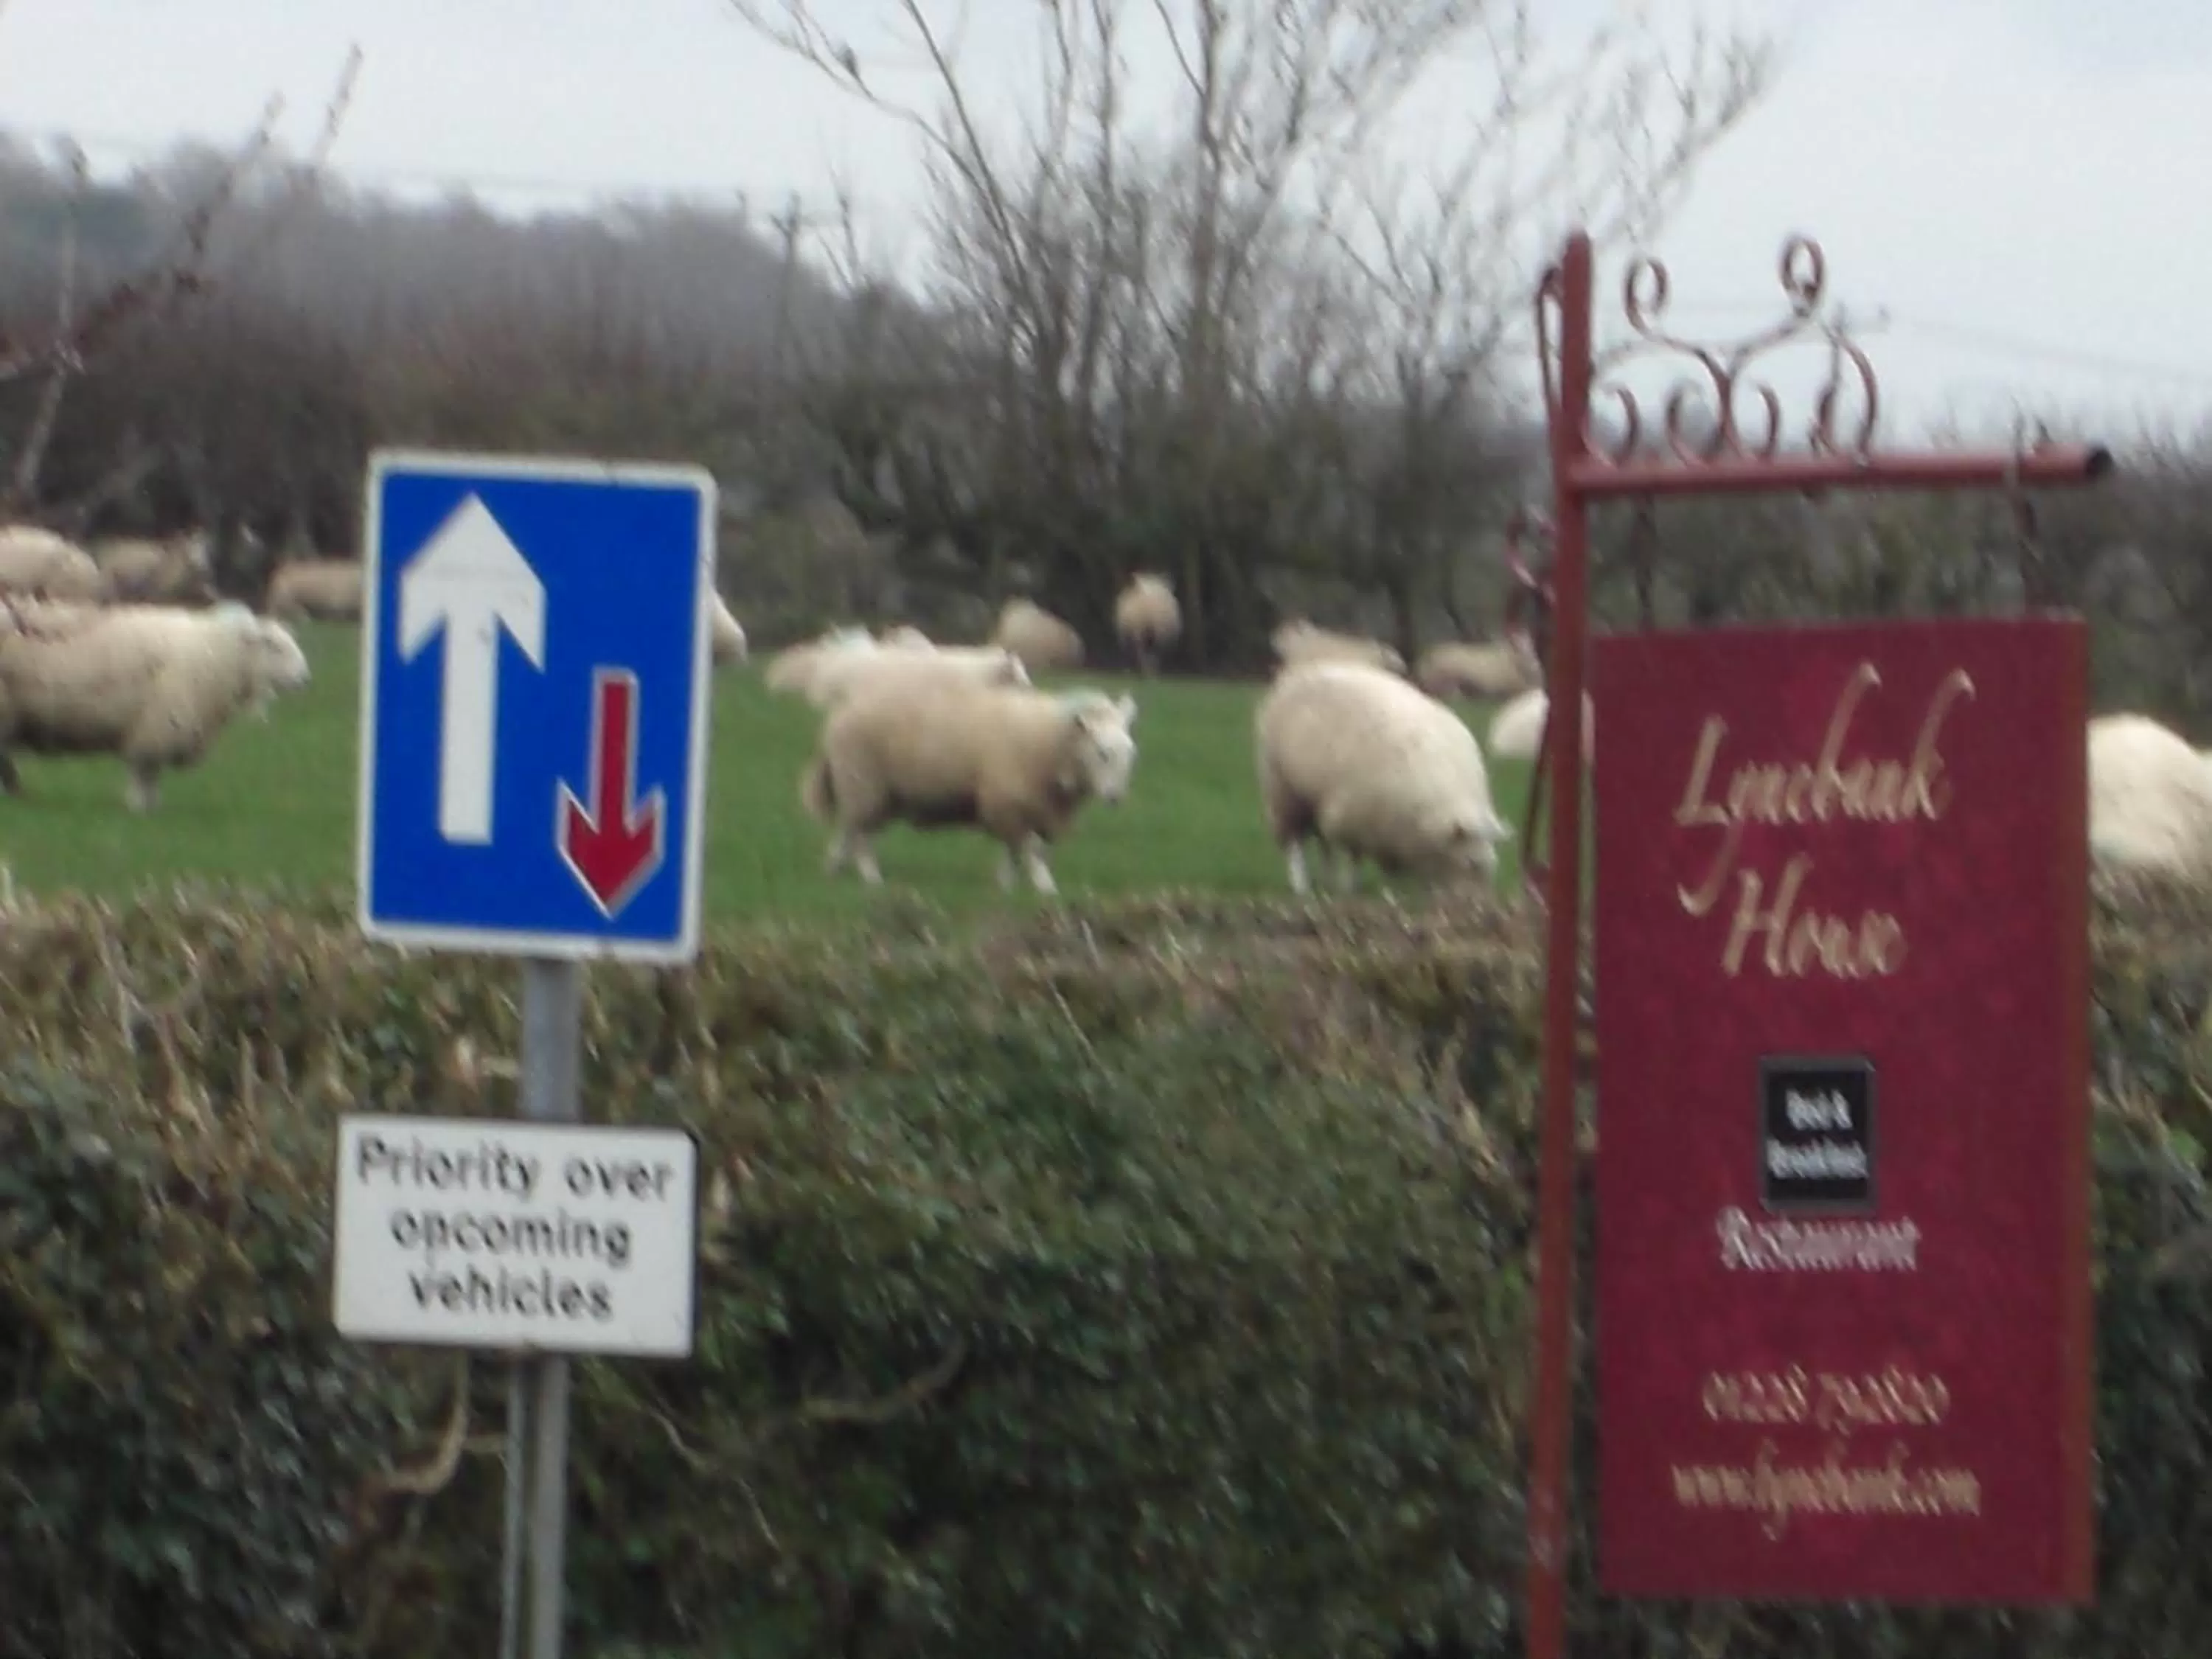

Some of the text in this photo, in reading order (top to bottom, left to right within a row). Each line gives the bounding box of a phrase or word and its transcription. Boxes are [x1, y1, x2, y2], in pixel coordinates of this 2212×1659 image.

[357, 1132, 672, 1205] Priority over
[408, 1259, 615, 1324] vehicles
